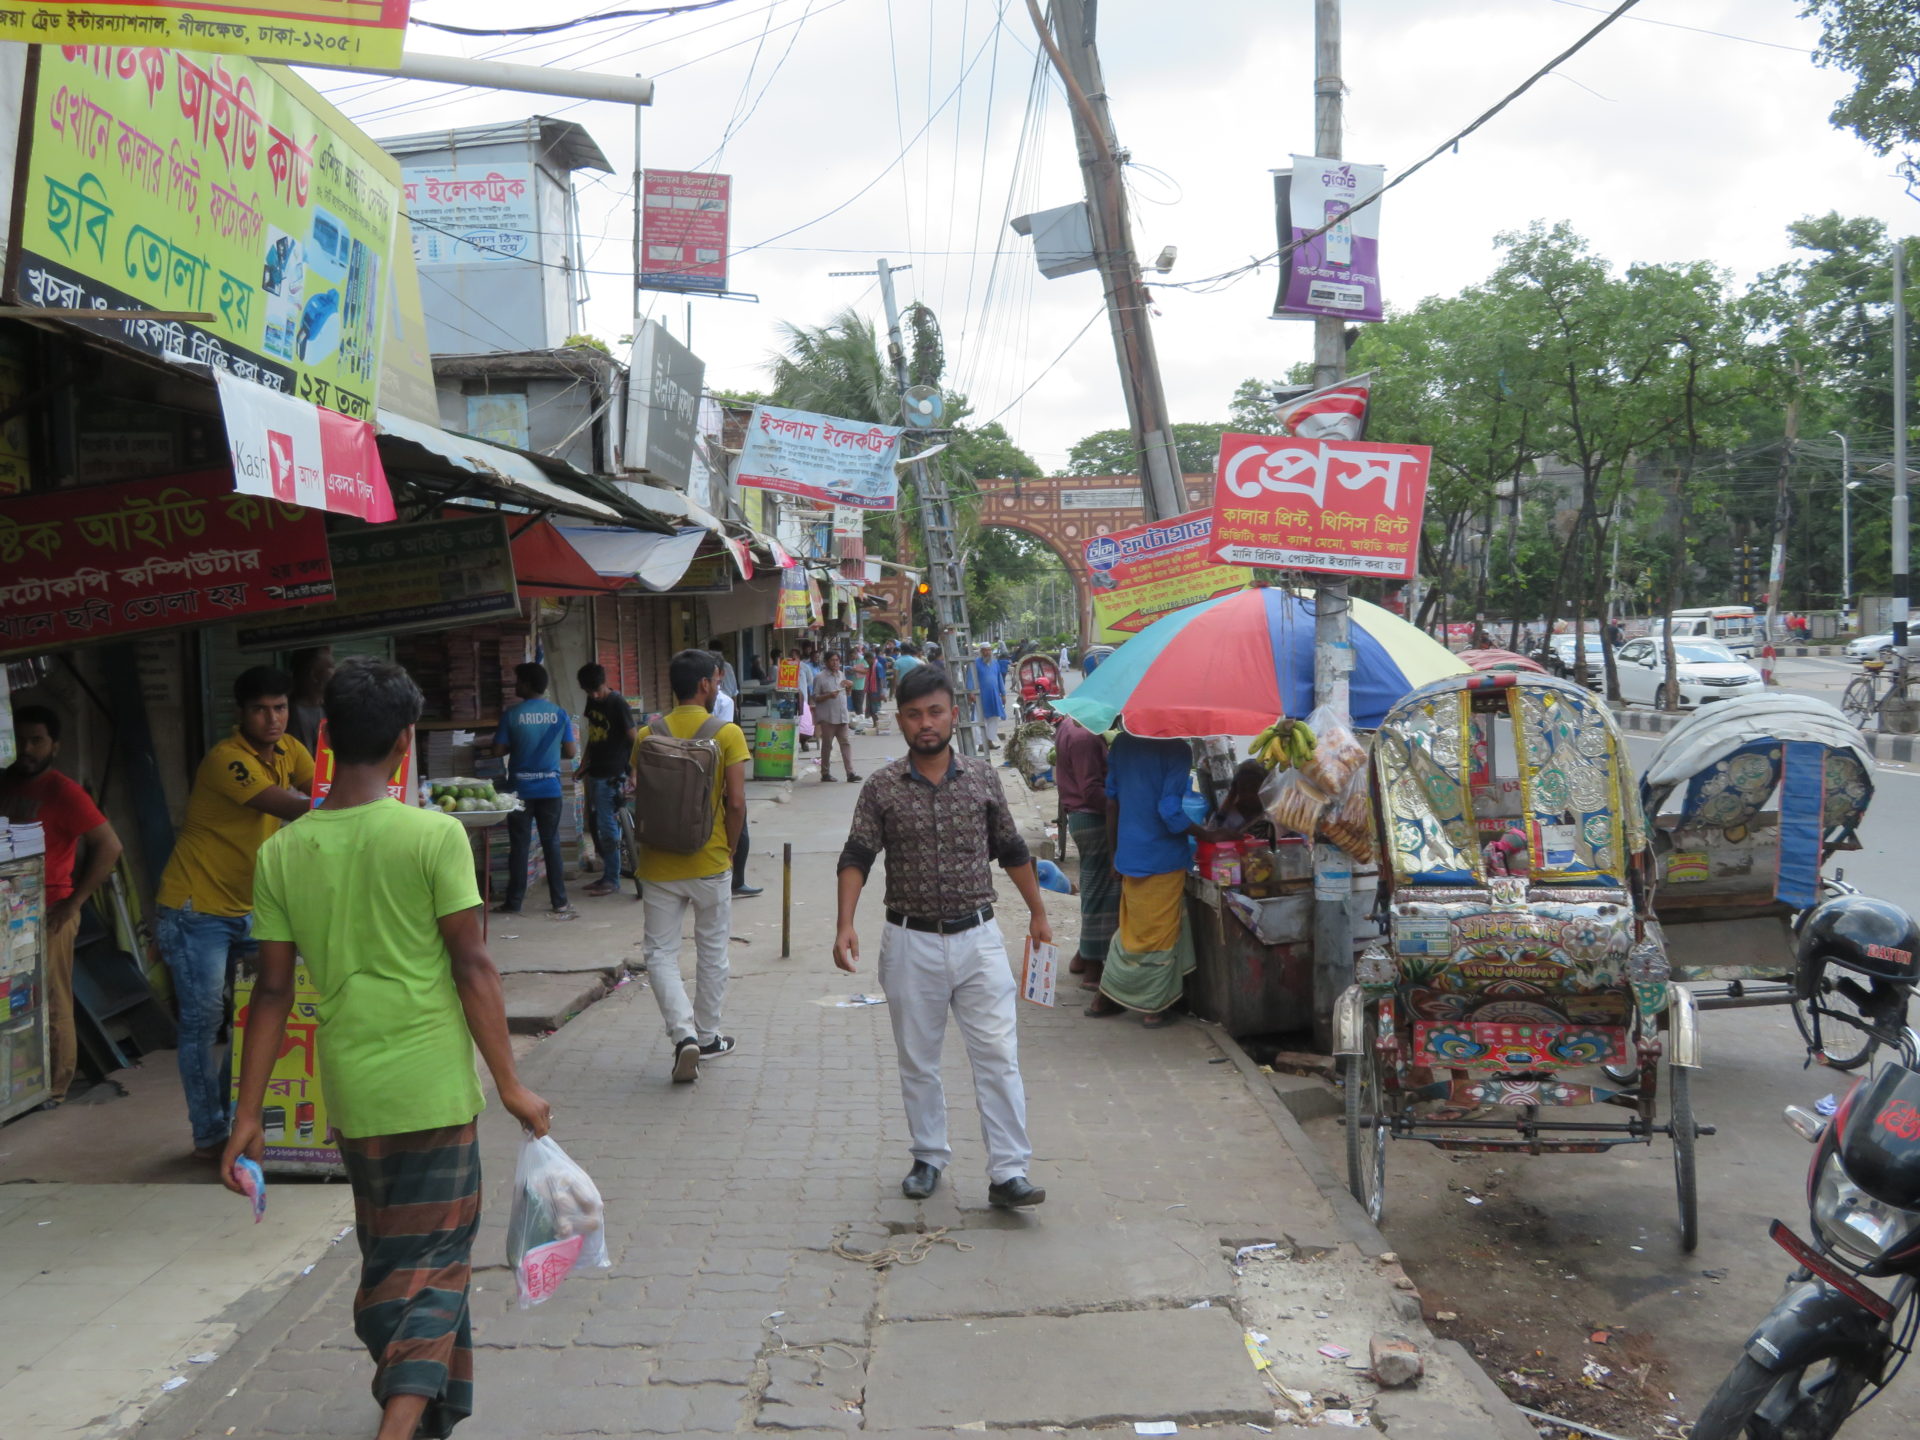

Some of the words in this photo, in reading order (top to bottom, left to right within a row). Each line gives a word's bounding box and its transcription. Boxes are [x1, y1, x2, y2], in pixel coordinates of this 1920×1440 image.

[31, 11, 61, 30] ট্রেড
[66, 10, 170, 37] ইন্টারন্যাশনাল,
[178, 14, 250, 44] নীলক্ষেত,
[177, 55, 263, 173] আইডি
[266, 133, 319, 208] কার্ড
[50, 85, 114, 161] এখানে
[117, 119, 165, 193] কালার
[209, 182, 264, 256] ফটোকপি
[425, 172, 527, 205] ইলেকট্রিক
[43, 172, 115, 265] ছবি
[124, 223, 211, 312] তোলা
[218, 268, 255, 335] হয়
[27, 267, 85, 311] খুচরা
[334, 385, 372, 421] তলা
[760, 411, 819, 441] ইসলাম
[823, 421, 897, 454] ইলেকট্রিক
[230, 440, 269, 480] Kash
[1225, 442, 1421, 511] প্রেস
[73, 488, 209, 551] আইডি
[1223, 508, 1270, 526] কালার
[1275, 507, 1313, 533] প্রিন্ট,
[1320, 511, 1369, 533] থিসিস
[1374, 514, 1411, 536] প্রিন্ট
[1218, 528, 1257, 543] ভিজিটিং
[1287, 535, 1312, 546] ক্যাশ
[1351, 537, 1382, 552] আইডি
[1387, 540, 1409, 554] কার্ড
[1232, 547, 1252, 560] মানি
[1329, 553, 1361, 568] ইত্যাদি
[1365, 558, 1384, 570] করা
[1387, 559, 1402, 572] হয়
[117, 548, 263, 589] কম্পিউটার
[63, 599, 116, 633] ছবি
[124, 588, 202, 622] তোলা
[205, 581, 250, 609] হয়
[228, 760, 249, 781] 3
